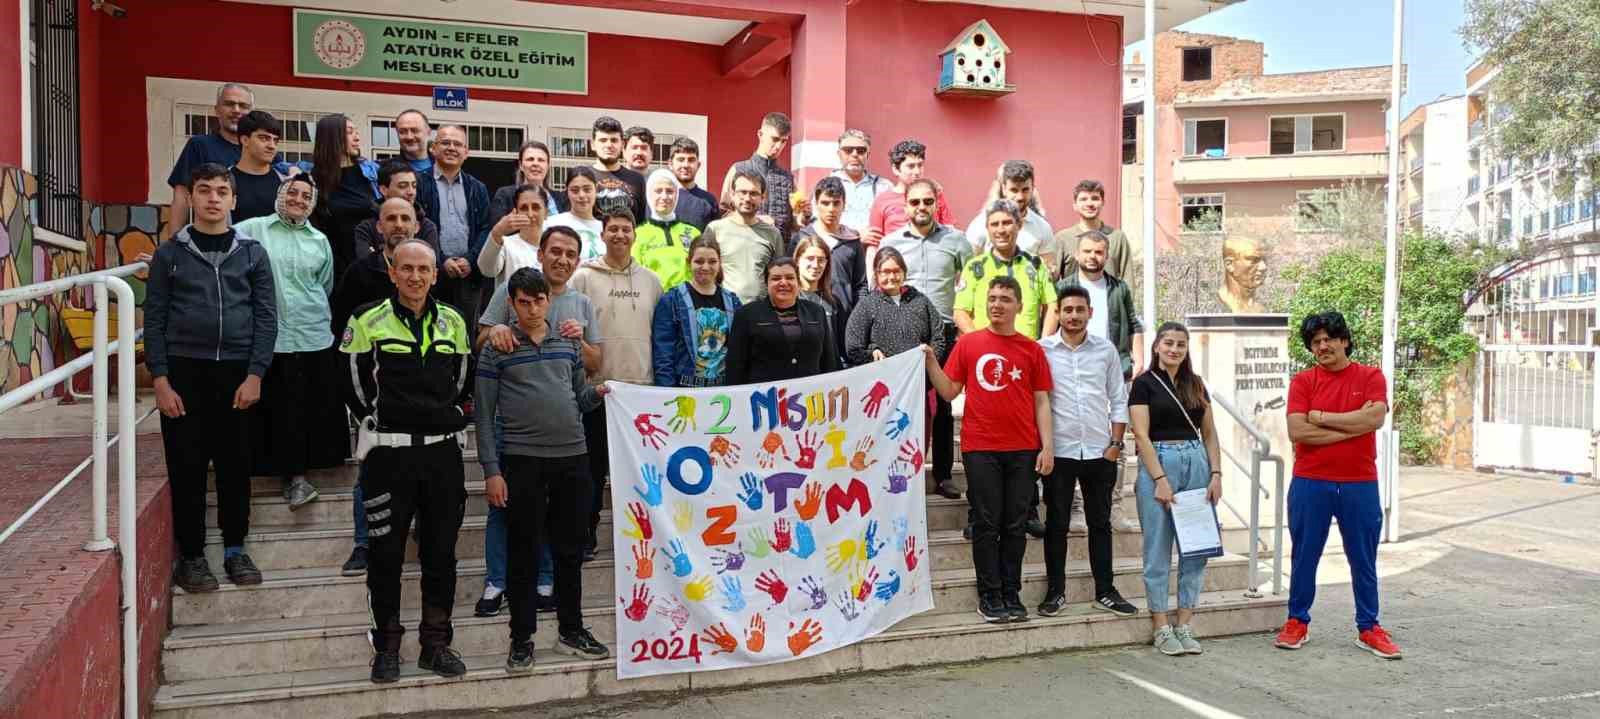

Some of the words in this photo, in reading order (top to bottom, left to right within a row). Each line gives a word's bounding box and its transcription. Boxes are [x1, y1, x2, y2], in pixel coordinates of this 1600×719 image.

[382, 26, 437, 41] AYDIN
[455, 31, 520, 47] EFELER
[382, 43, 465, 59] ATATÜRK
[470, 47, 514, 63] ÖZEL
[519, 51, 576, 67] EĞİTİM
[383, 60, 456, 76] MESLEK
[460, 65, 520, 80] OKULU
[436, 99, 465, 108] BLOK
[446, 90, 455, 98] A
[704, 394, 737, 435] 2
[631, 633, 703, 664] 2024
